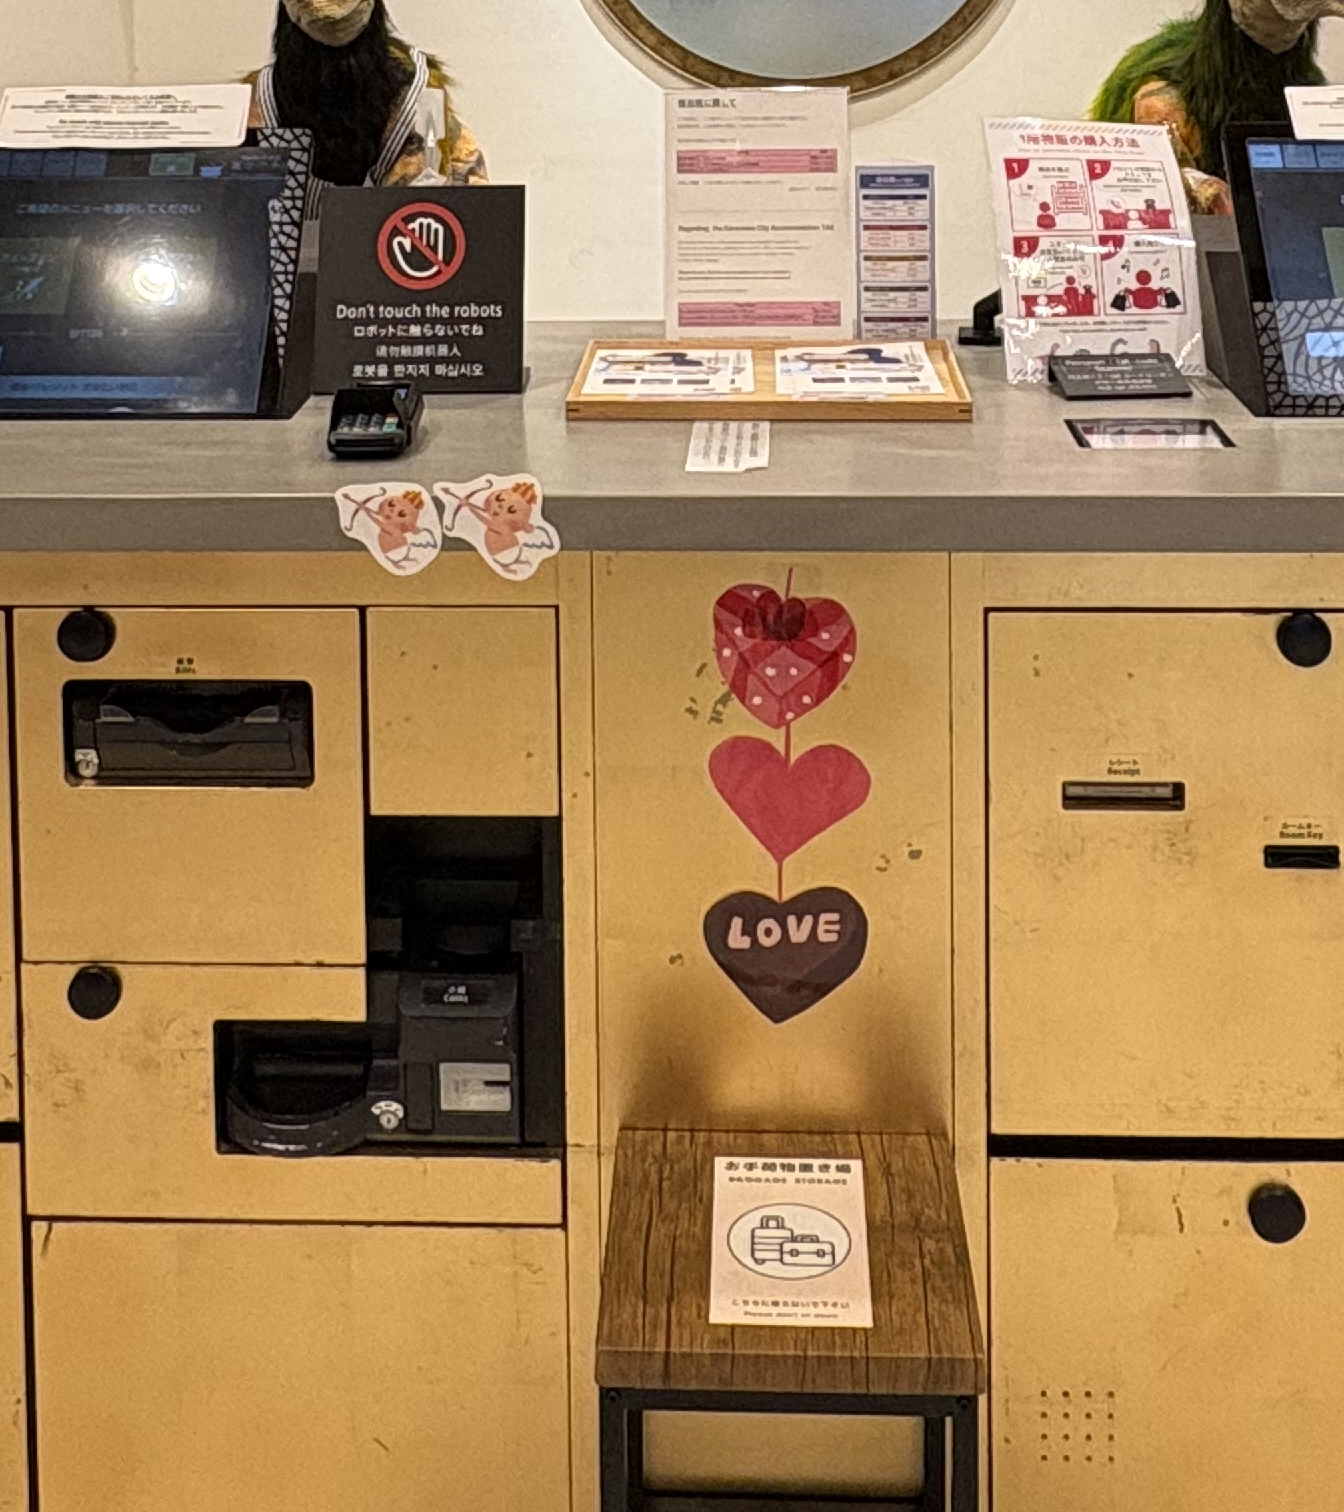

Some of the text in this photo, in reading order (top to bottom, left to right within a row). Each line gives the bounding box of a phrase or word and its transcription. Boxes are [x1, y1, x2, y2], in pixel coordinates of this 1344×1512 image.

[1012, 162, 1020, 174] 1
[1093, 162, 1102, 174] 2
[1020, 241, 1029, 253] 3
[336, 302, 504, 320] Don't touch the robots
[353, 323, 485, 338] ロボットに触らないでね
[727, 912, 842, 950] LOVE
